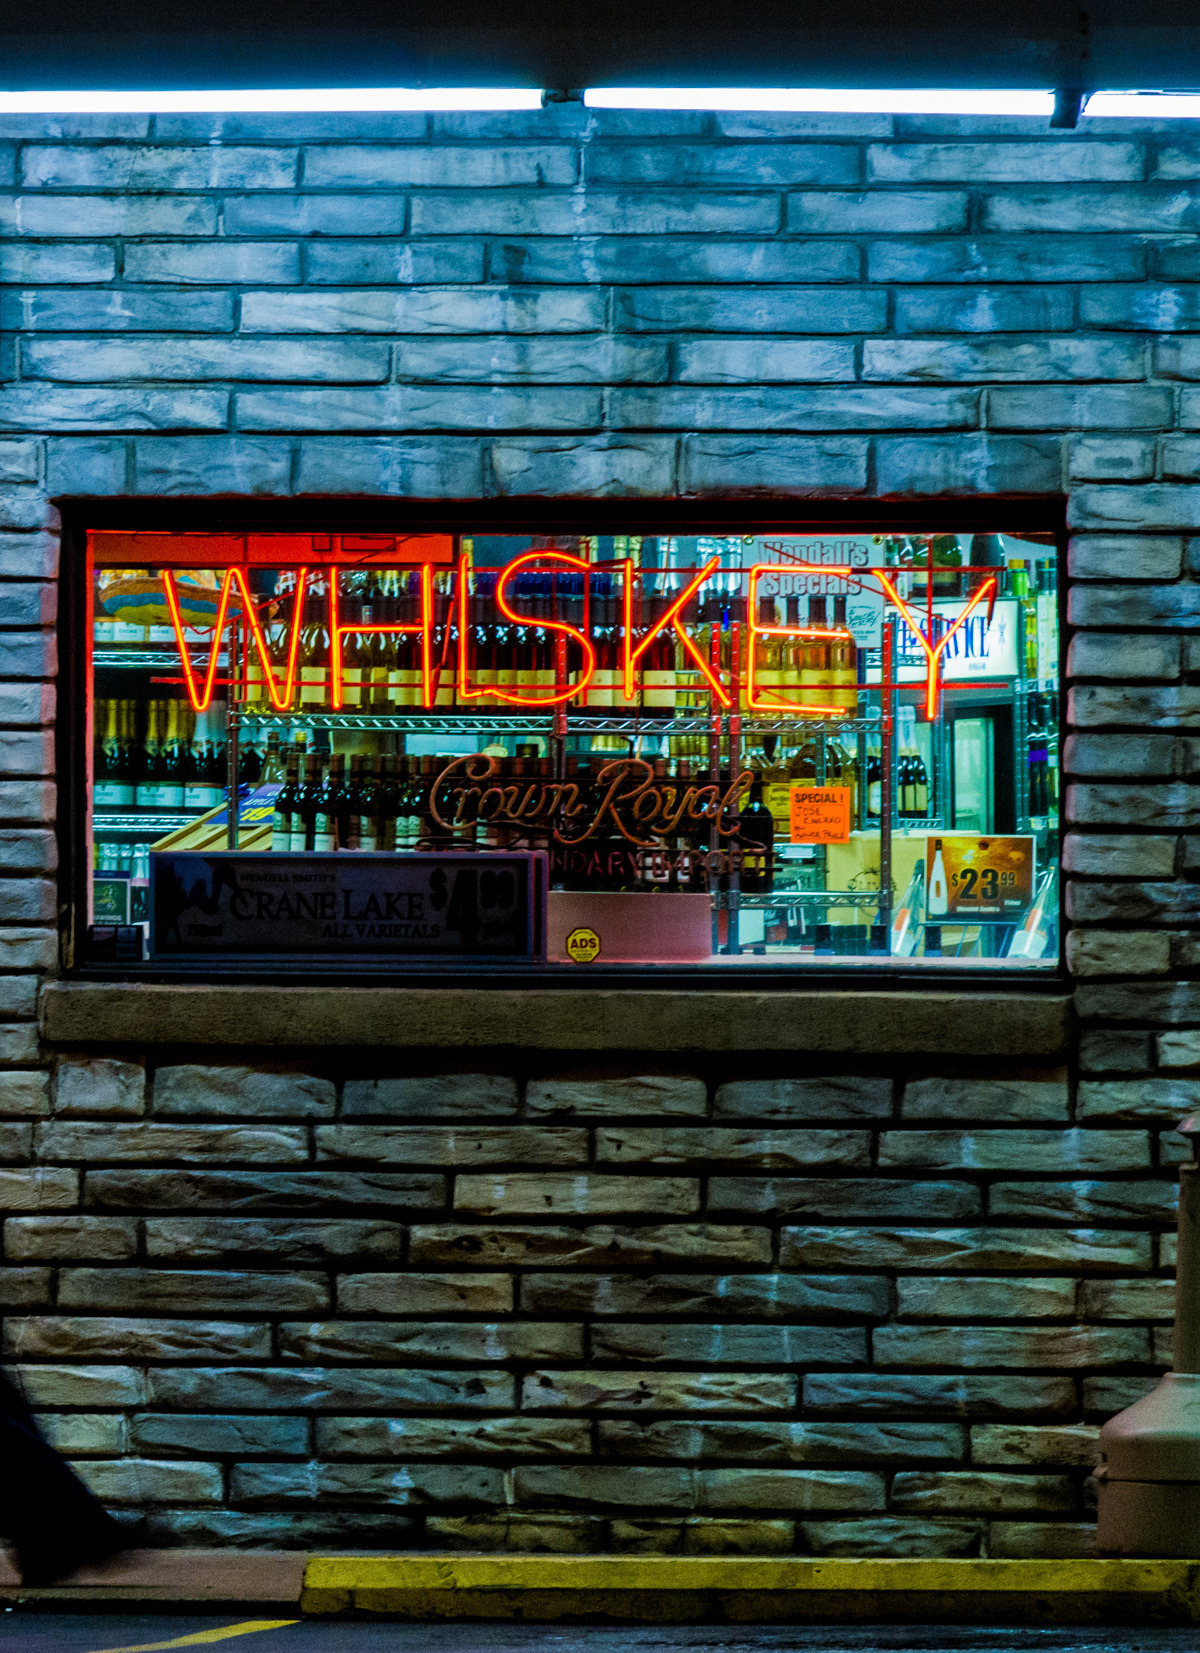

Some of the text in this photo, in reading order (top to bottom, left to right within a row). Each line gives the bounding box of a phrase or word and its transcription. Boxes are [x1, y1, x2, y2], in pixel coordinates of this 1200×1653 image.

[765, 573, 862, 599] Specials
[161, 552, 997, 720] WHISKEY
[429, 753, 755, 847] Crown Royal
[550, 850, 642, 878] NDARY
[230, 888, 424, 920] CRANE LAKE
[322, 924, 440, 938] ALL VARIETALS
[570, 938, 597, 949] ADS
